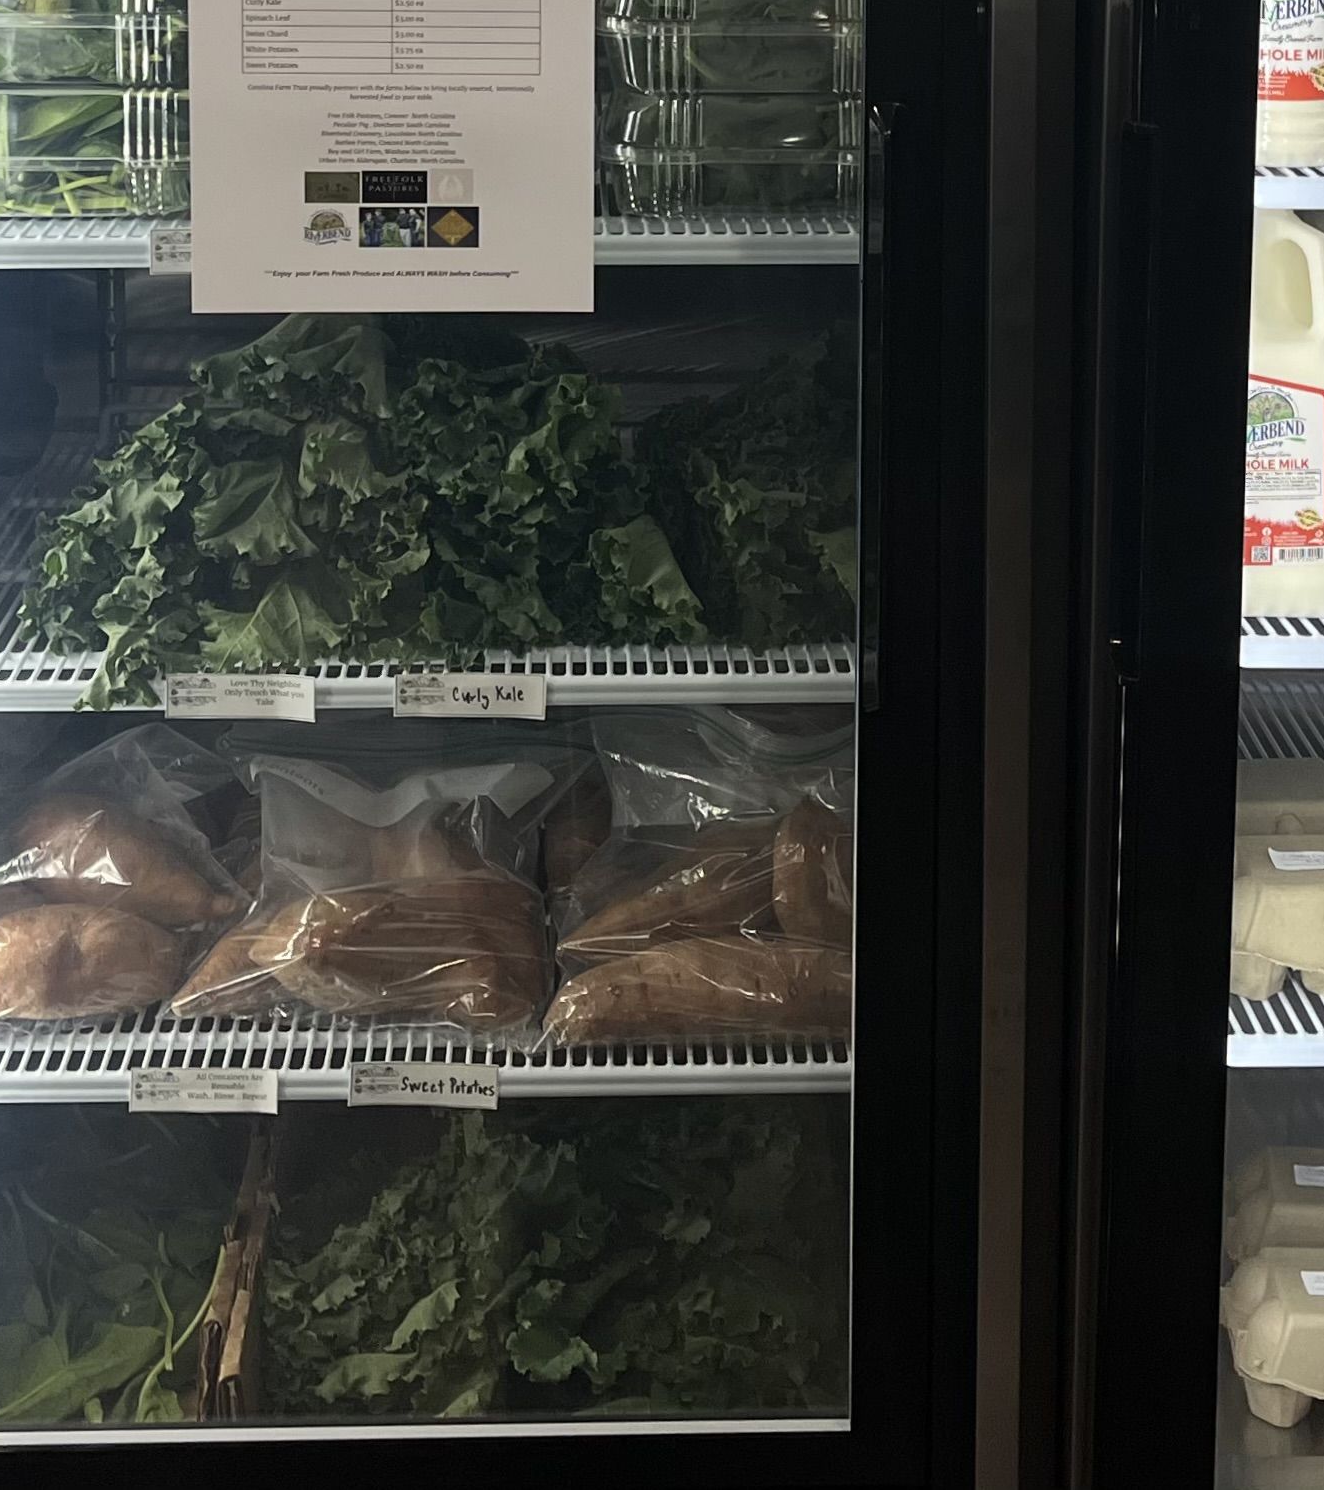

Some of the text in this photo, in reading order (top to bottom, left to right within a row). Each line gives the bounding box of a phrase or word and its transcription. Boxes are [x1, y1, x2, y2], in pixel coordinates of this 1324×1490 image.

[1260, 48, 1303, 62] HOLE
[368, 185, 420, 193] PASTURES
[1246, 458, 1309, 471] HOLE MILK
[230, 679, 301, 689] Love Thy Neighbor
[224, 689, 244, 698] Only
[246, 689, 268, 697] Touch
[270, 689, 289, 697] What
[451, 684, 524, 709] Curly Kale
[255, 698, 274, 706] Take
[195, 1073, 263, 1082] All Containers Are
[400, 1076, 495, 1097] Sweet Potatoes
